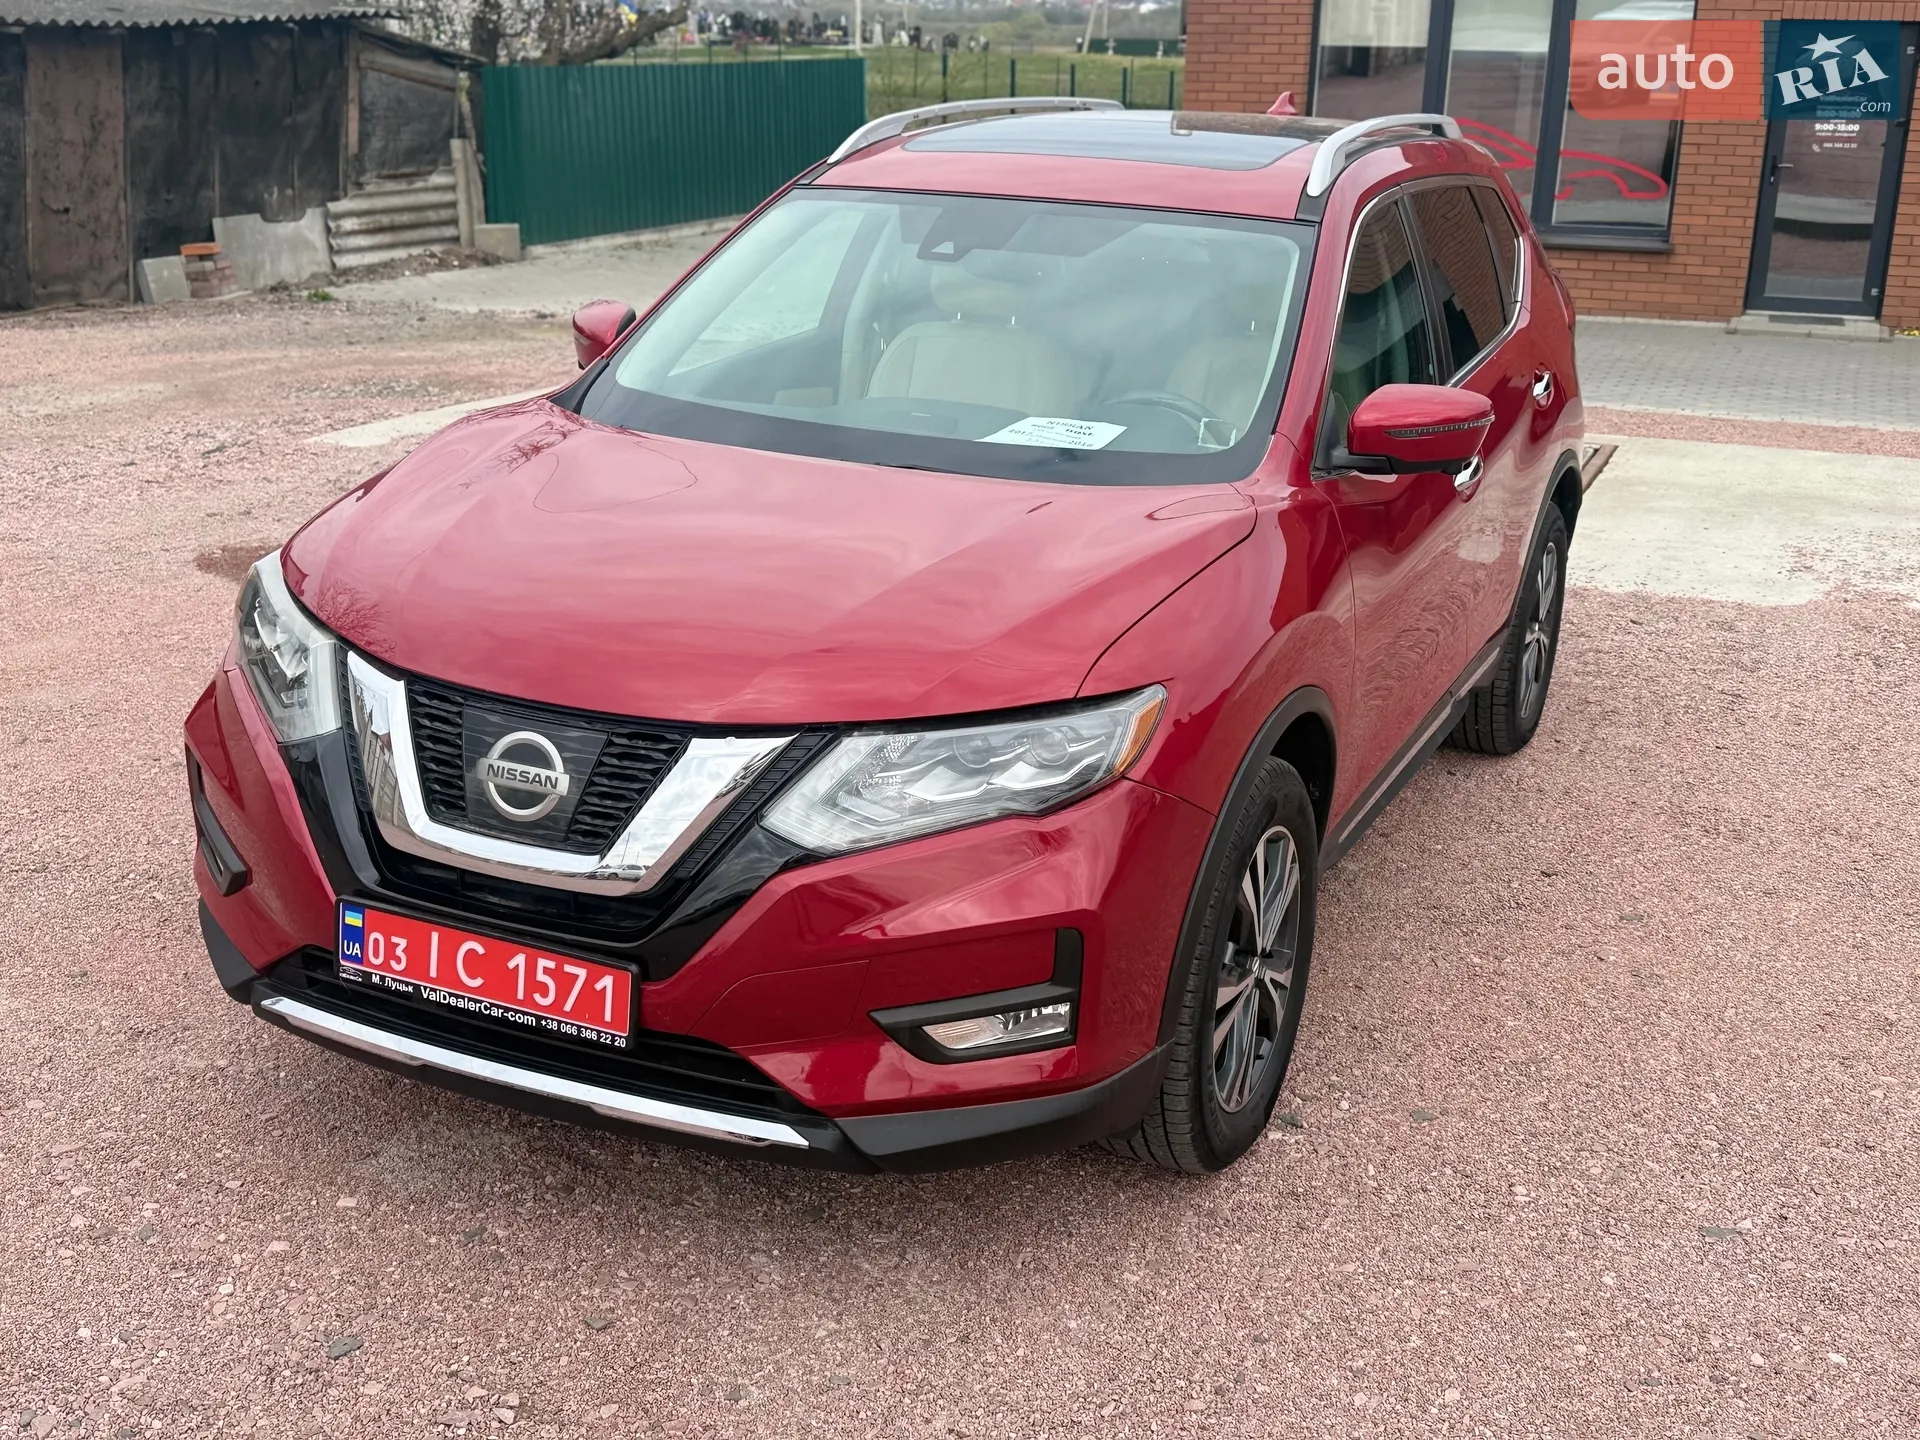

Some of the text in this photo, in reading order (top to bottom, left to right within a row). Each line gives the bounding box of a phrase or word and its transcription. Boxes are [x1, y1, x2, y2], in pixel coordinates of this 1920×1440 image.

[1814, 123, 1860, 131] 9:00-15:00
[486, 763, 559, 790] NISSAN
[344, 939, 362, 958] UA
[367, 931, 408, 972] 03
[506, 952, 615, 1023] 1571
[371, 974, 383, 986] М.
[384, 976, 414, 993] Луцьк
[420, 986, 536, 1027] ValDealerCar-com
[541, 1018, 627, 1048] +38 066 366 22 20
